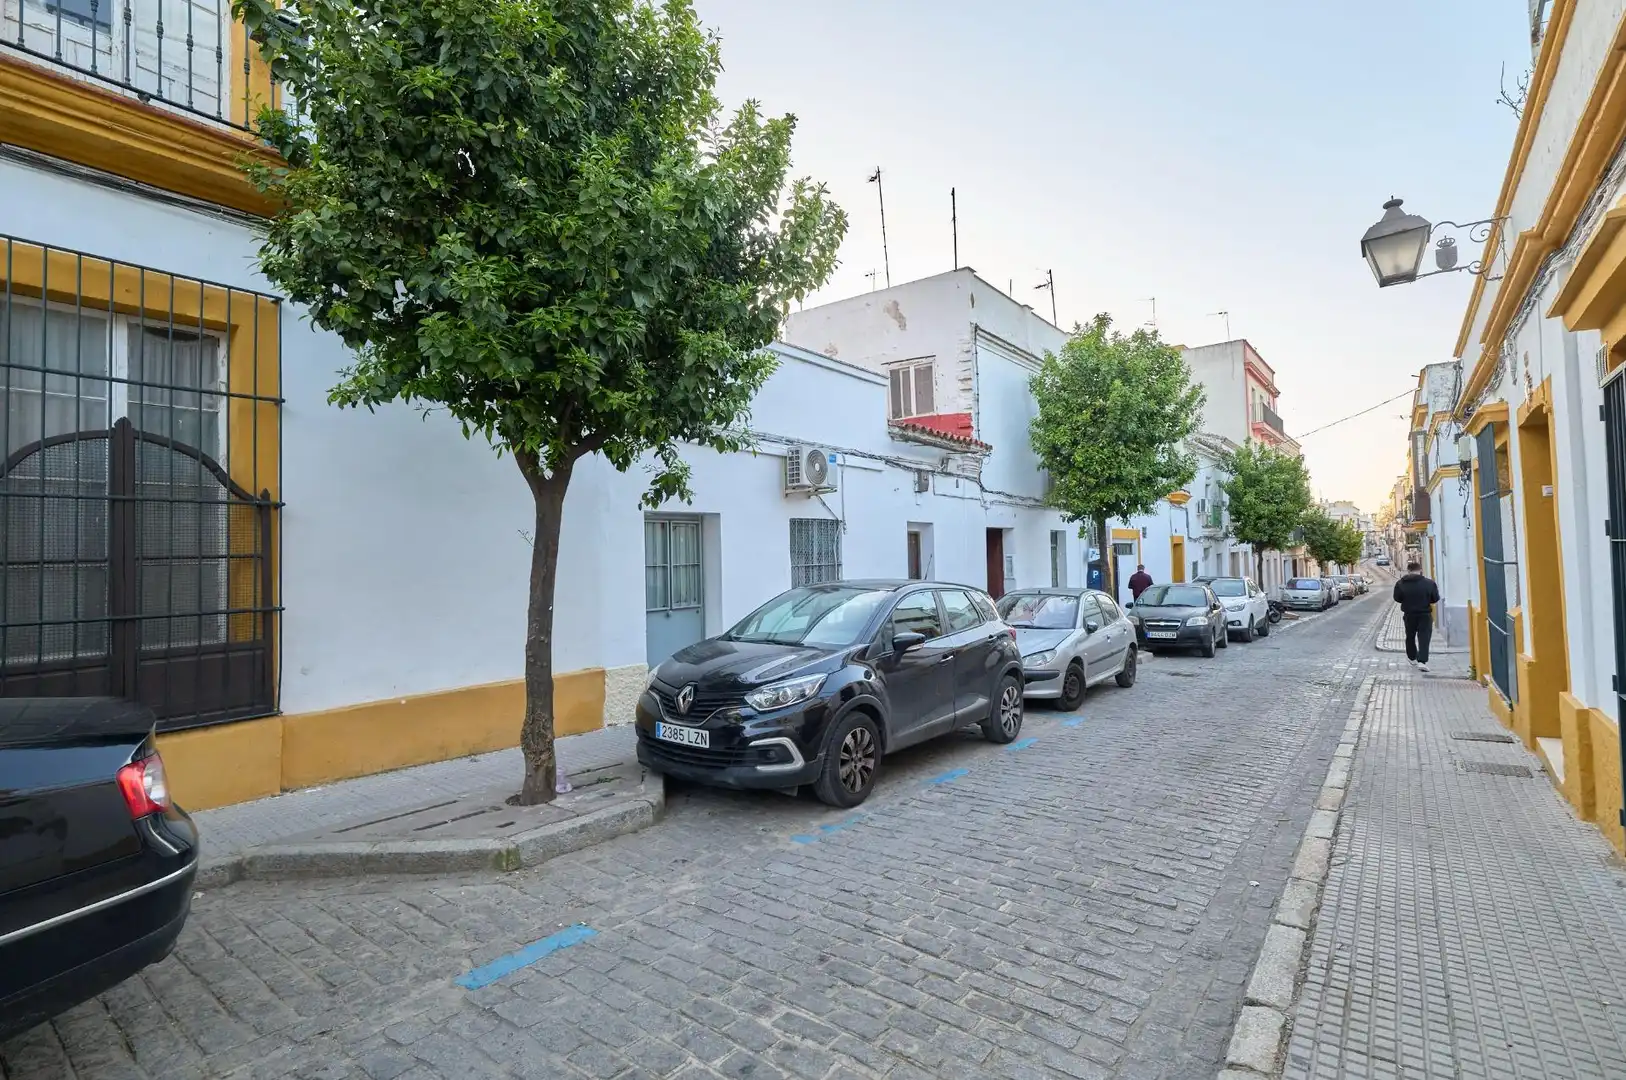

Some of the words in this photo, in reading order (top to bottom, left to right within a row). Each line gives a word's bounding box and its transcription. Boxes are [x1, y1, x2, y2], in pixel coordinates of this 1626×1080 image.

[1092, 570, 1099, 579] P
[661, 725, 685, 742] 2385
[687, 730, 708, 746] LZN
